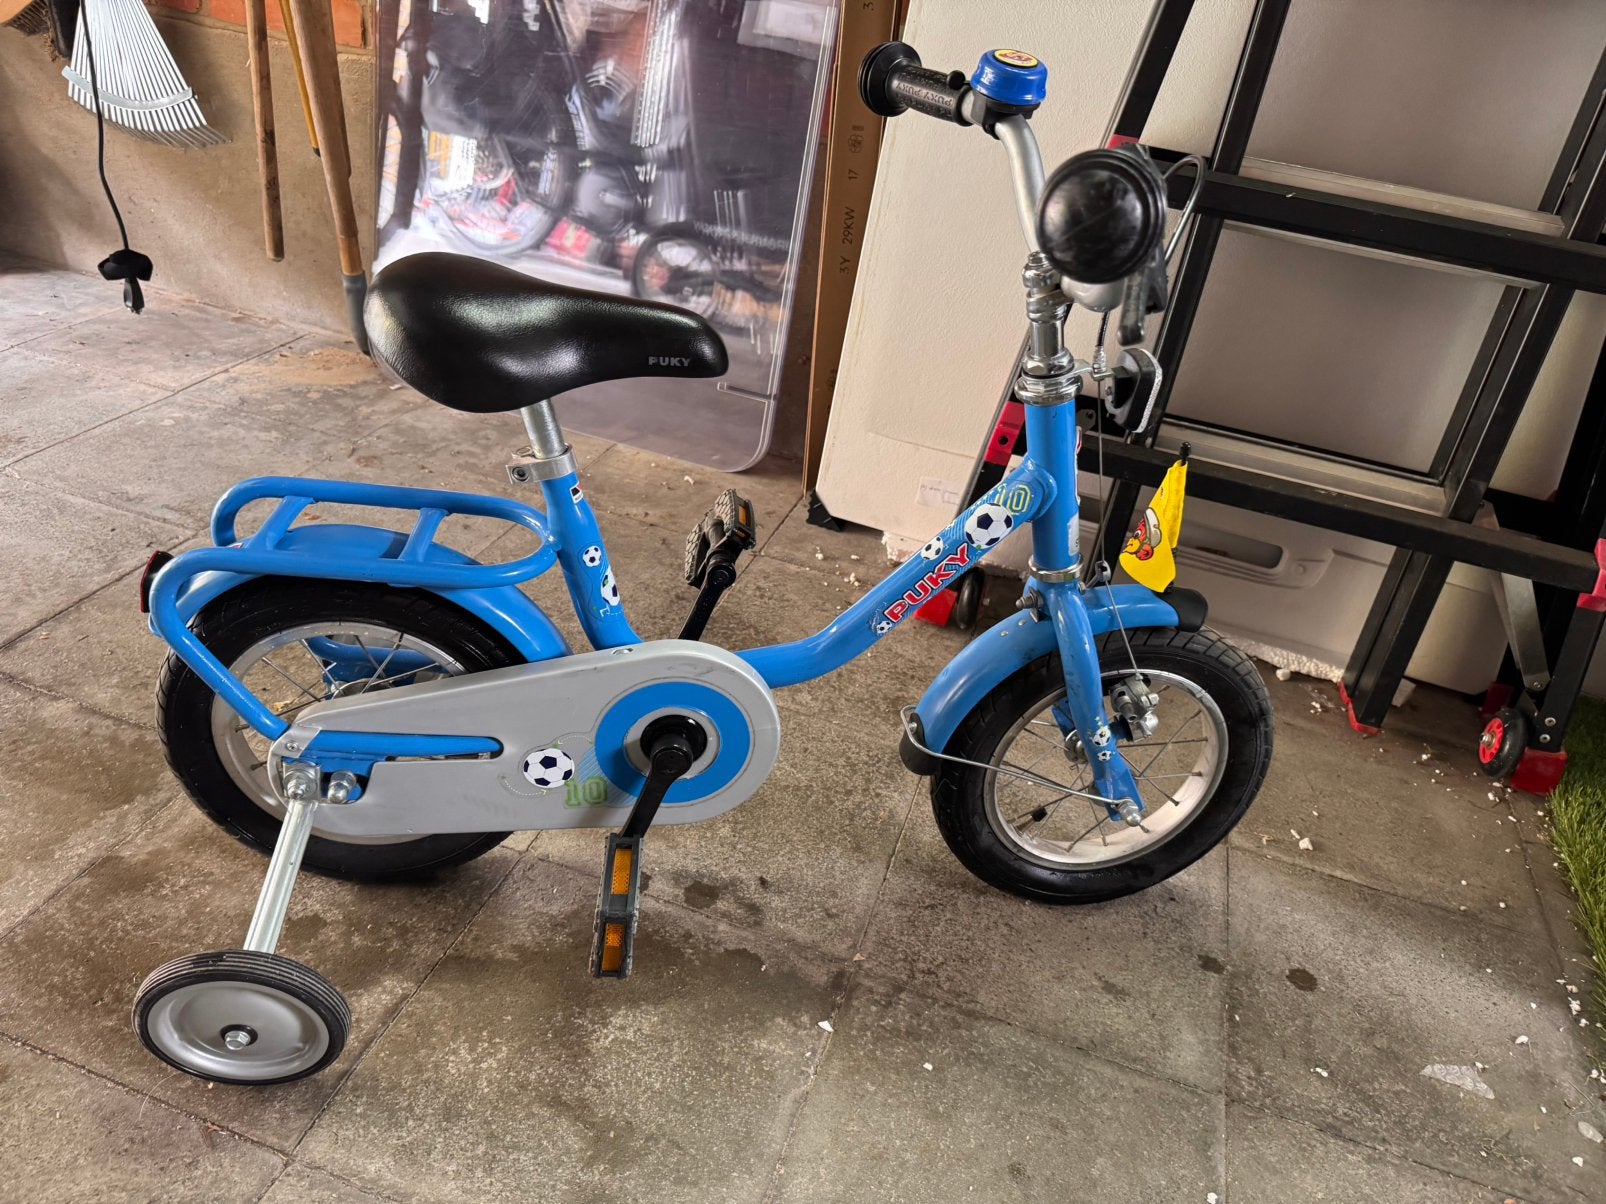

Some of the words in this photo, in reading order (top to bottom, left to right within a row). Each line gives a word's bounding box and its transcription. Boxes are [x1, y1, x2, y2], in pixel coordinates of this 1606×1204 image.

[895, 81, 922, 97] PUKY
[924, 91, 953, 107] PUKY
[848, 169, 860, 181] 17
[842, 206, 857, 246] 29KW
[648, 356, 690, 367] PUKY
[994, 483, 1031, 516] 10
[883, 542, 970, 623] PUKY
[564, 776, 608, 807] 10
